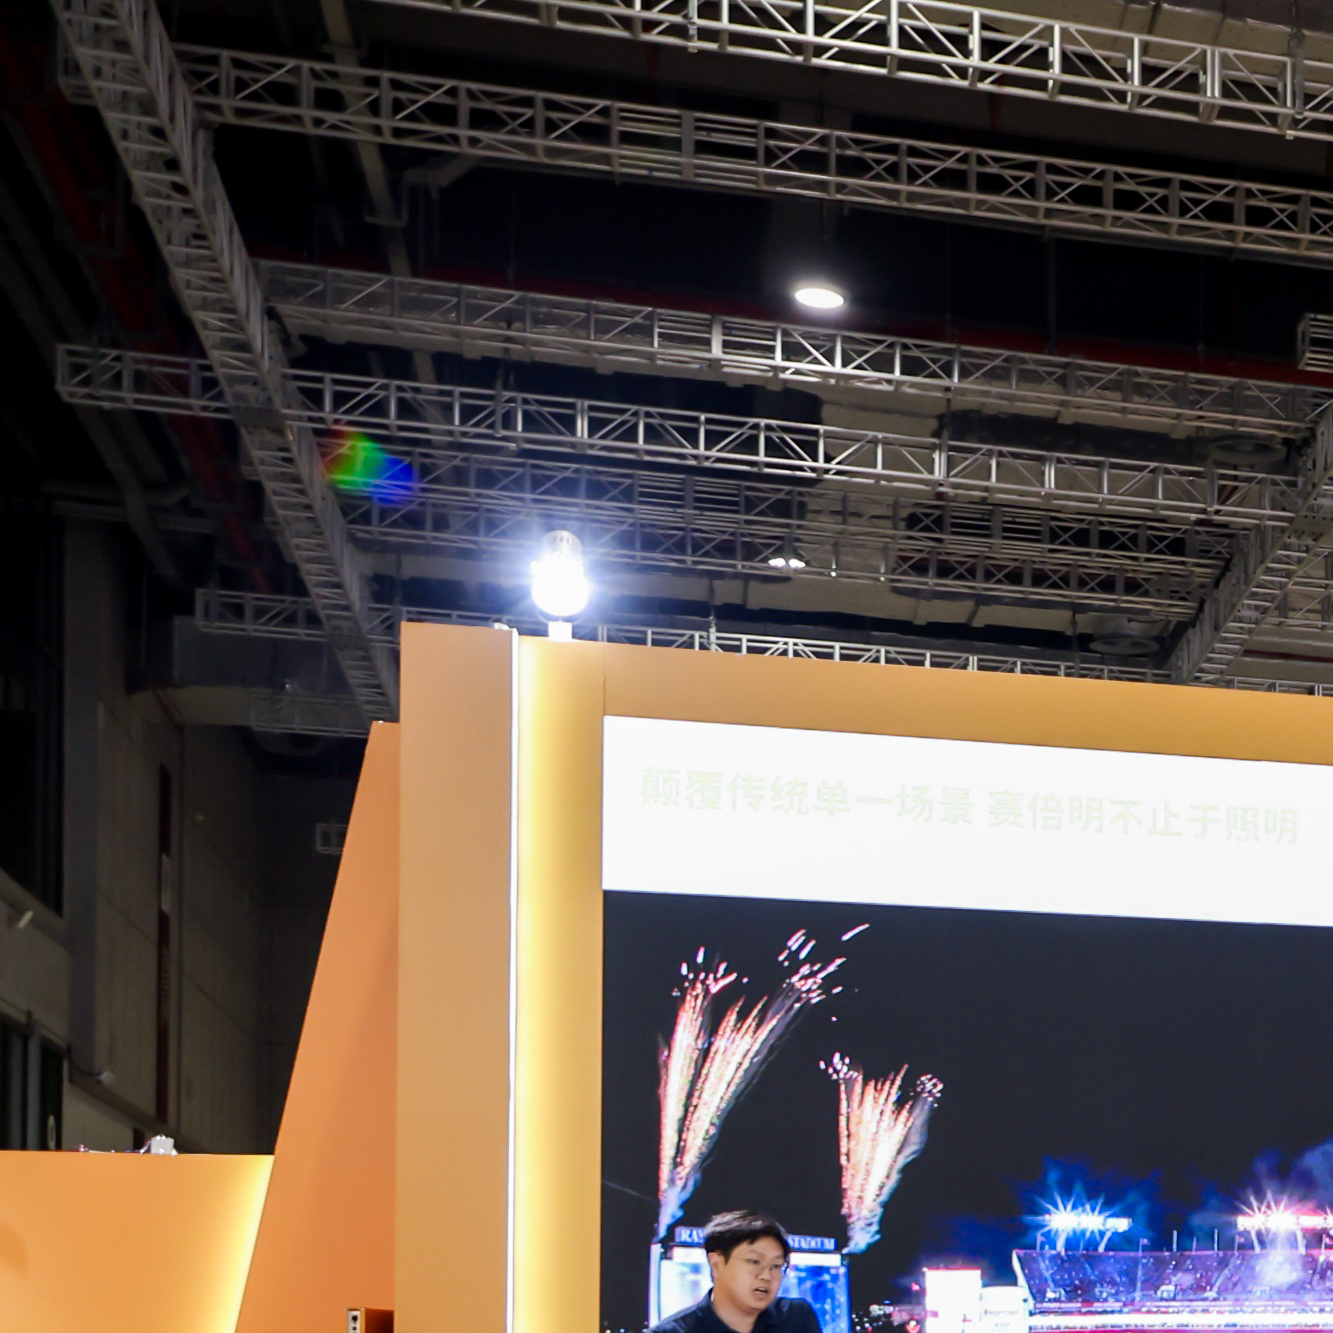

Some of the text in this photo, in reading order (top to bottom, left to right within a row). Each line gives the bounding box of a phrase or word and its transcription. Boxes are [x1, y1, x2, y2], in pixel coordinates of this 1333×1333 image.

[639, 765, 1300, 847] 颠覆传统单一场景 赛倍明不止于照明
